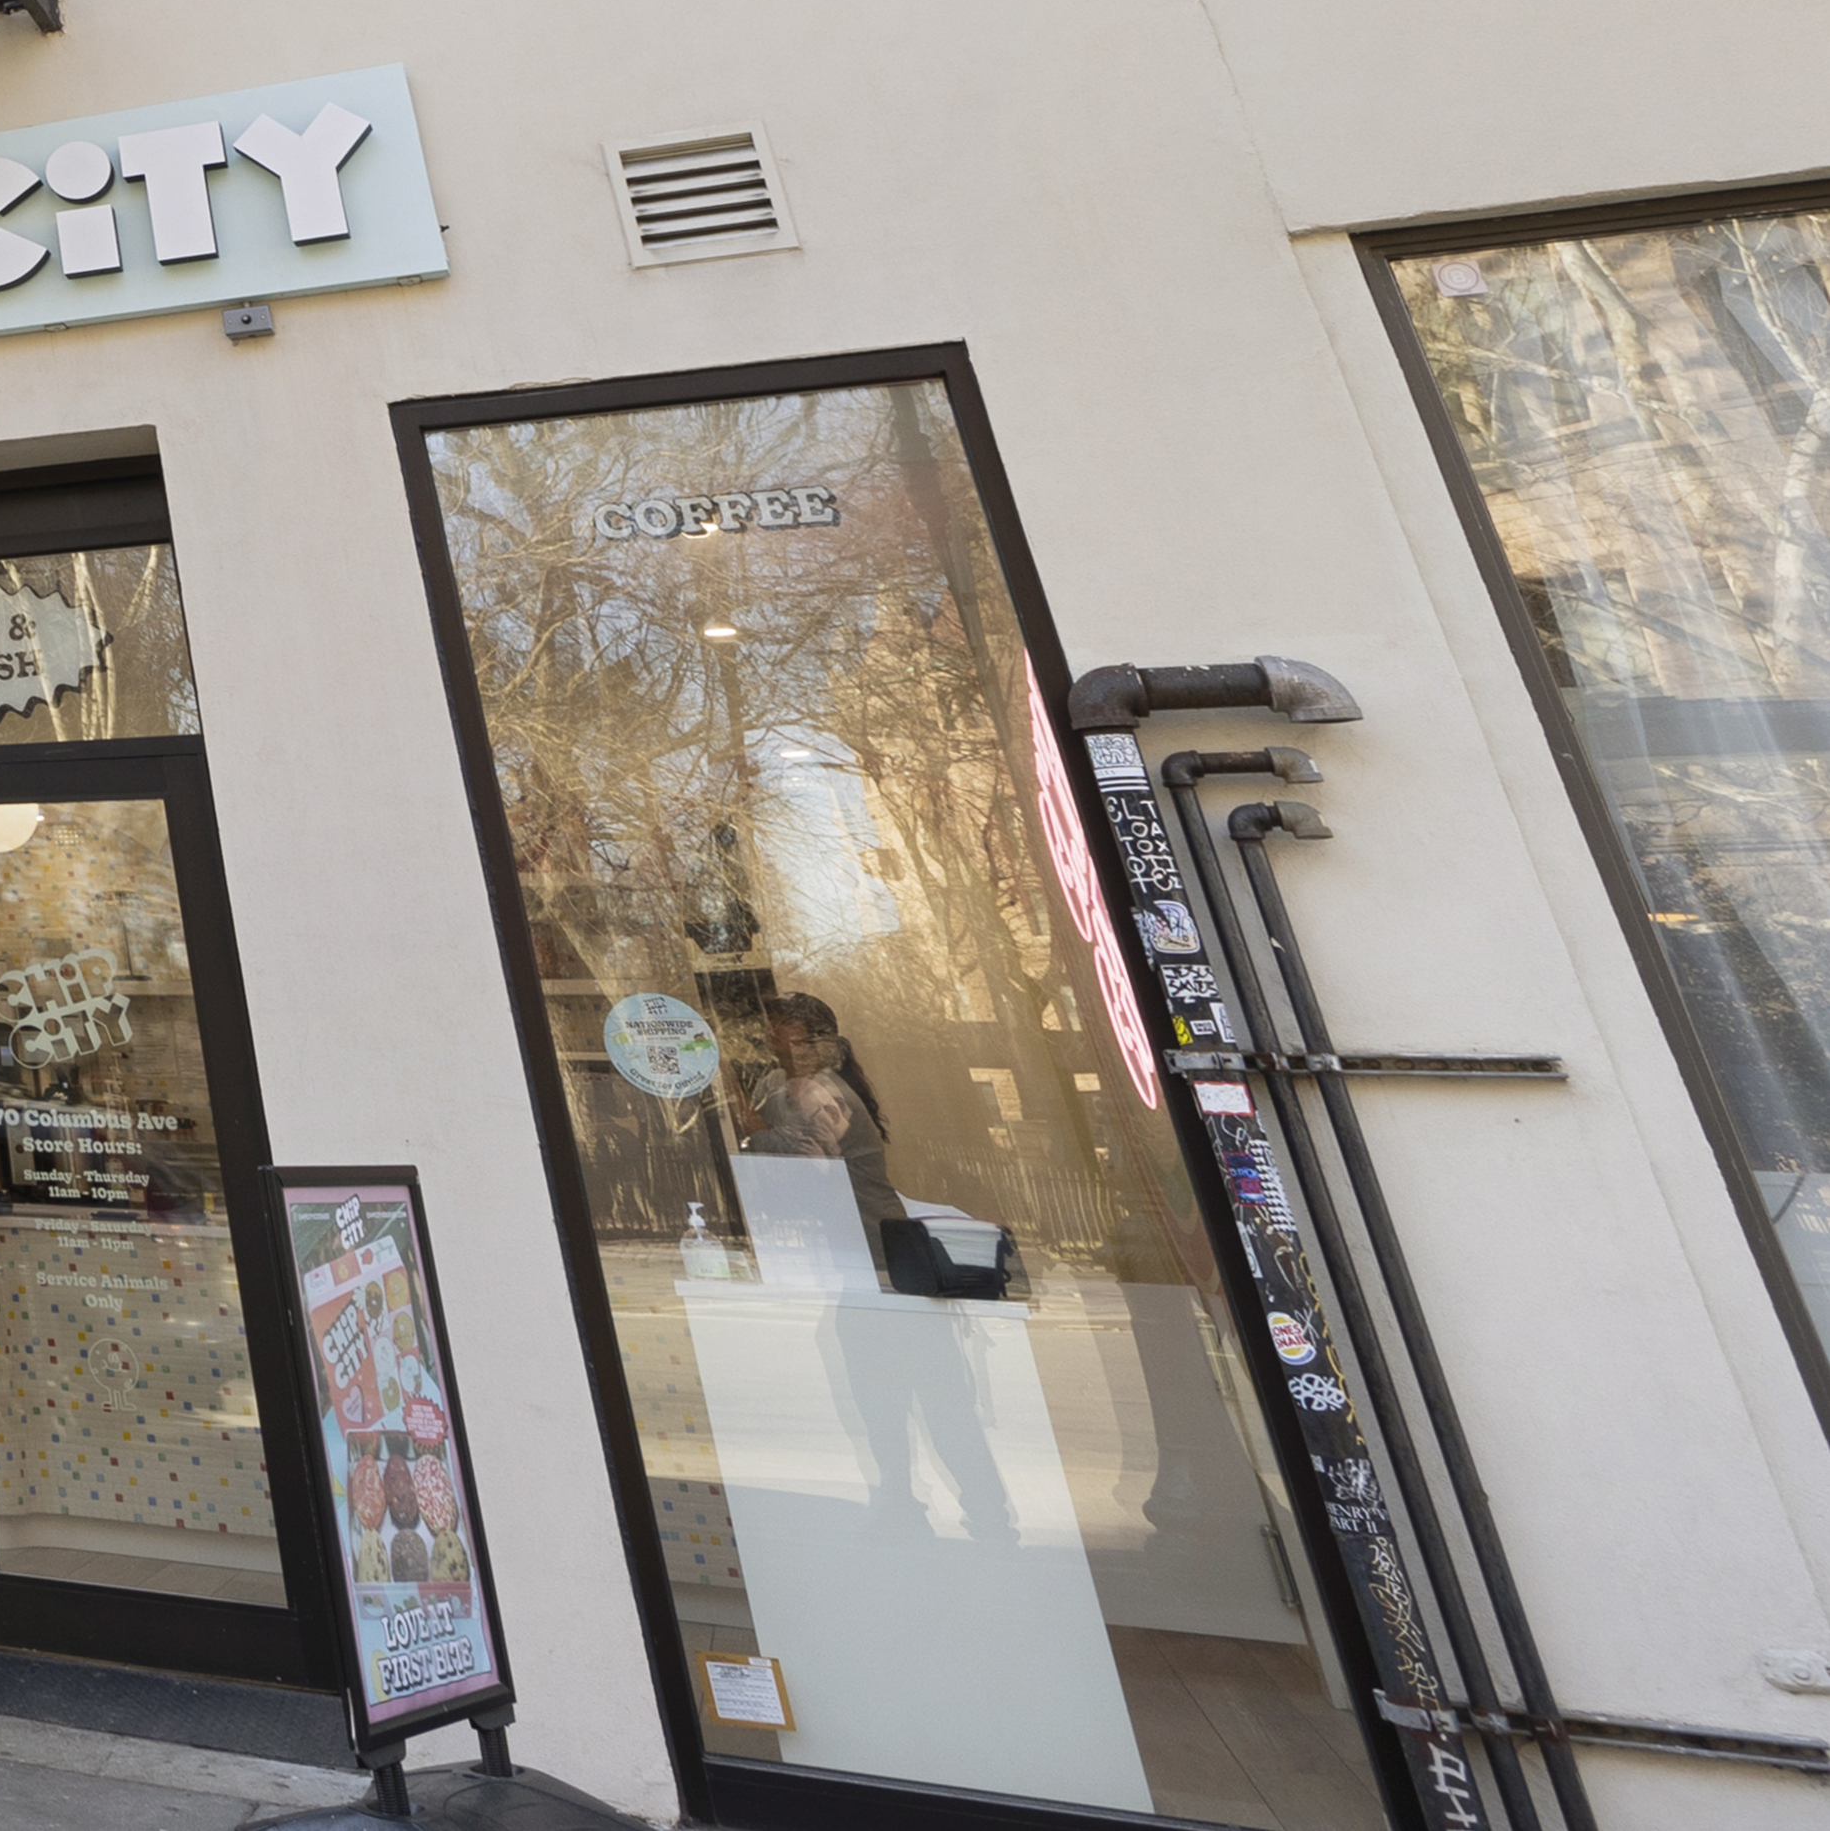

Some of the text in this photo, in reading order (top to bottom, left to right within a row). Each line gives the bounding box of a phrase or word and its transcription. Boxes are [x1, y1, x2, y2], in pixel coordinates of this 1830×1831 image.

[594, 485, 841, 540] COFFEE
[9, 614, 36, 641] &
[625, 1020, 694, 1029] NATIONWIDE
[637, 1028, 687, 1036] SHIPPING
[24, 1108, 132, 1129] Columbus
[137, 1112, 178, 1130] Ave
[22, 1136, 142, 1155] Store Hours:
[23, 1169, 73, 1184] Sunday
[83, 1170, 150, 1188] Thursday
[48, 1186, 81, 1198] 11am
[91, 1187, 129, 1202] 10pm
[35, 1219, 79, 1233] Friday
[90, 1221, 153, 1236] Saturday
[57, 1236, 90, 1248] 11am
[100, 1237, 135, 1252] 11pm
[36, 1271, 169, 1291] Service Animals
[85, 1293, 124, 1312] Only
[381, 1601, 455, 1651] LOVE AT
[378, 1636, 475, 1696] FIRST BITE
